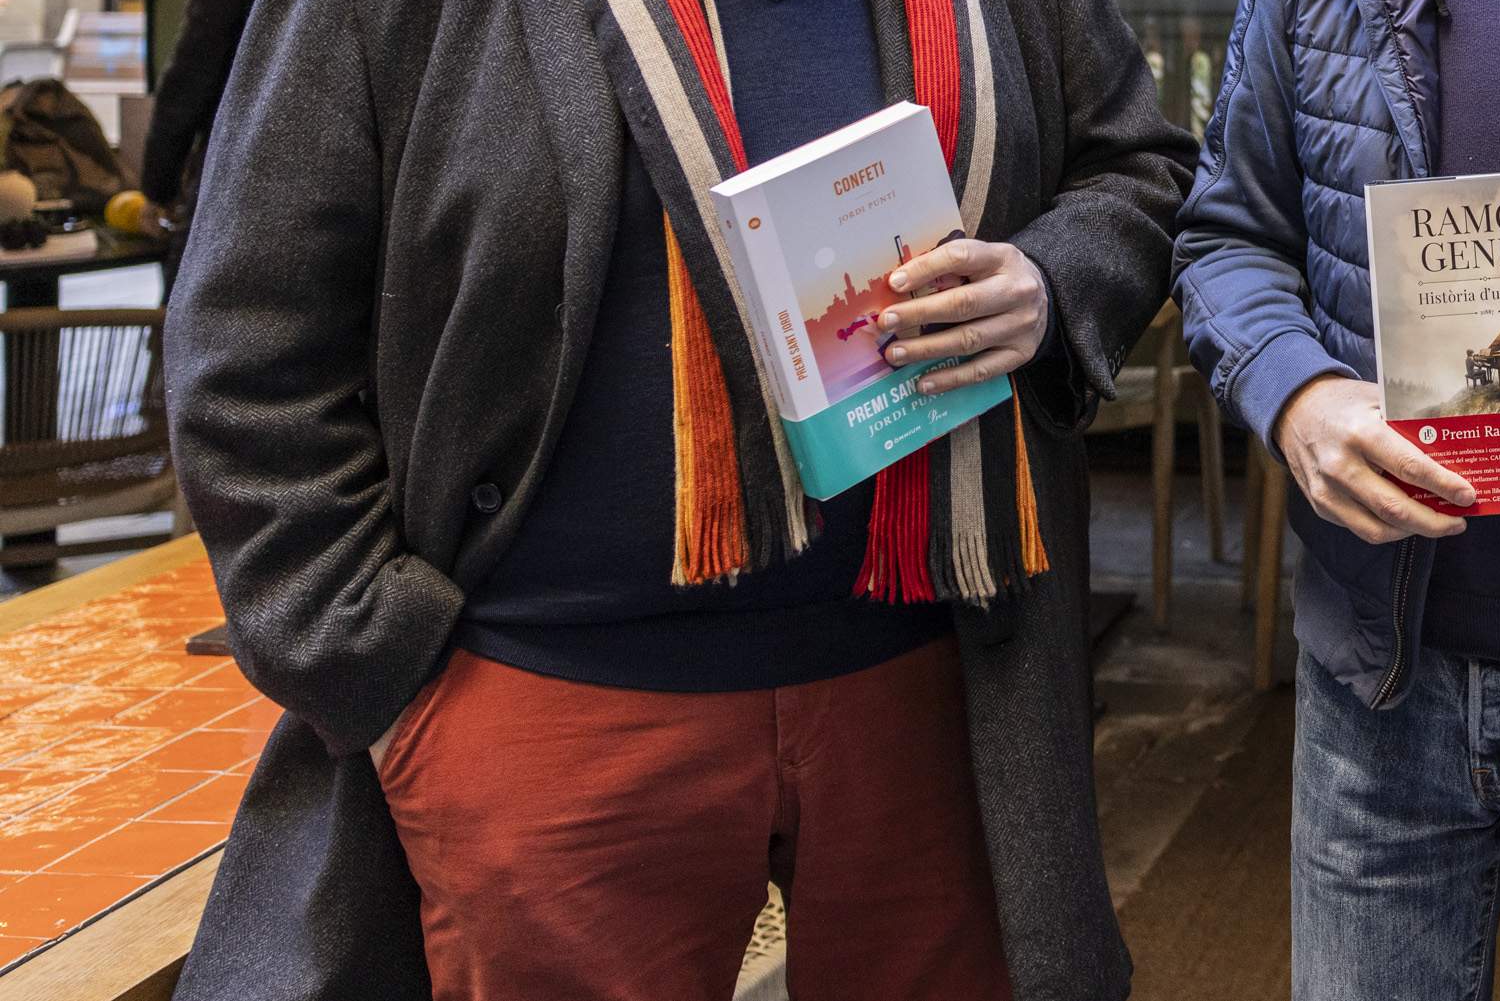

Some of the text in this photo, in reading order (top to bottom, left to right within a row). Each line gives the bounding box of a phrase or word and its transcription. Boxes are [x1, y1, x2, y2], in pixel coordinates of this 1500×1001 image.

[833, 160, 886, 197] CONFETI
[837, 205, 866, 225] JORDI
[1418, 289, 1476, 305] Història
[777, 308, 809, 382] PREMI SANT JORDI
[846, 392, 889, 429] PREMI
[868, 407, 908, 438] JORDI
[1442, 428, 1480, 441] Premi
